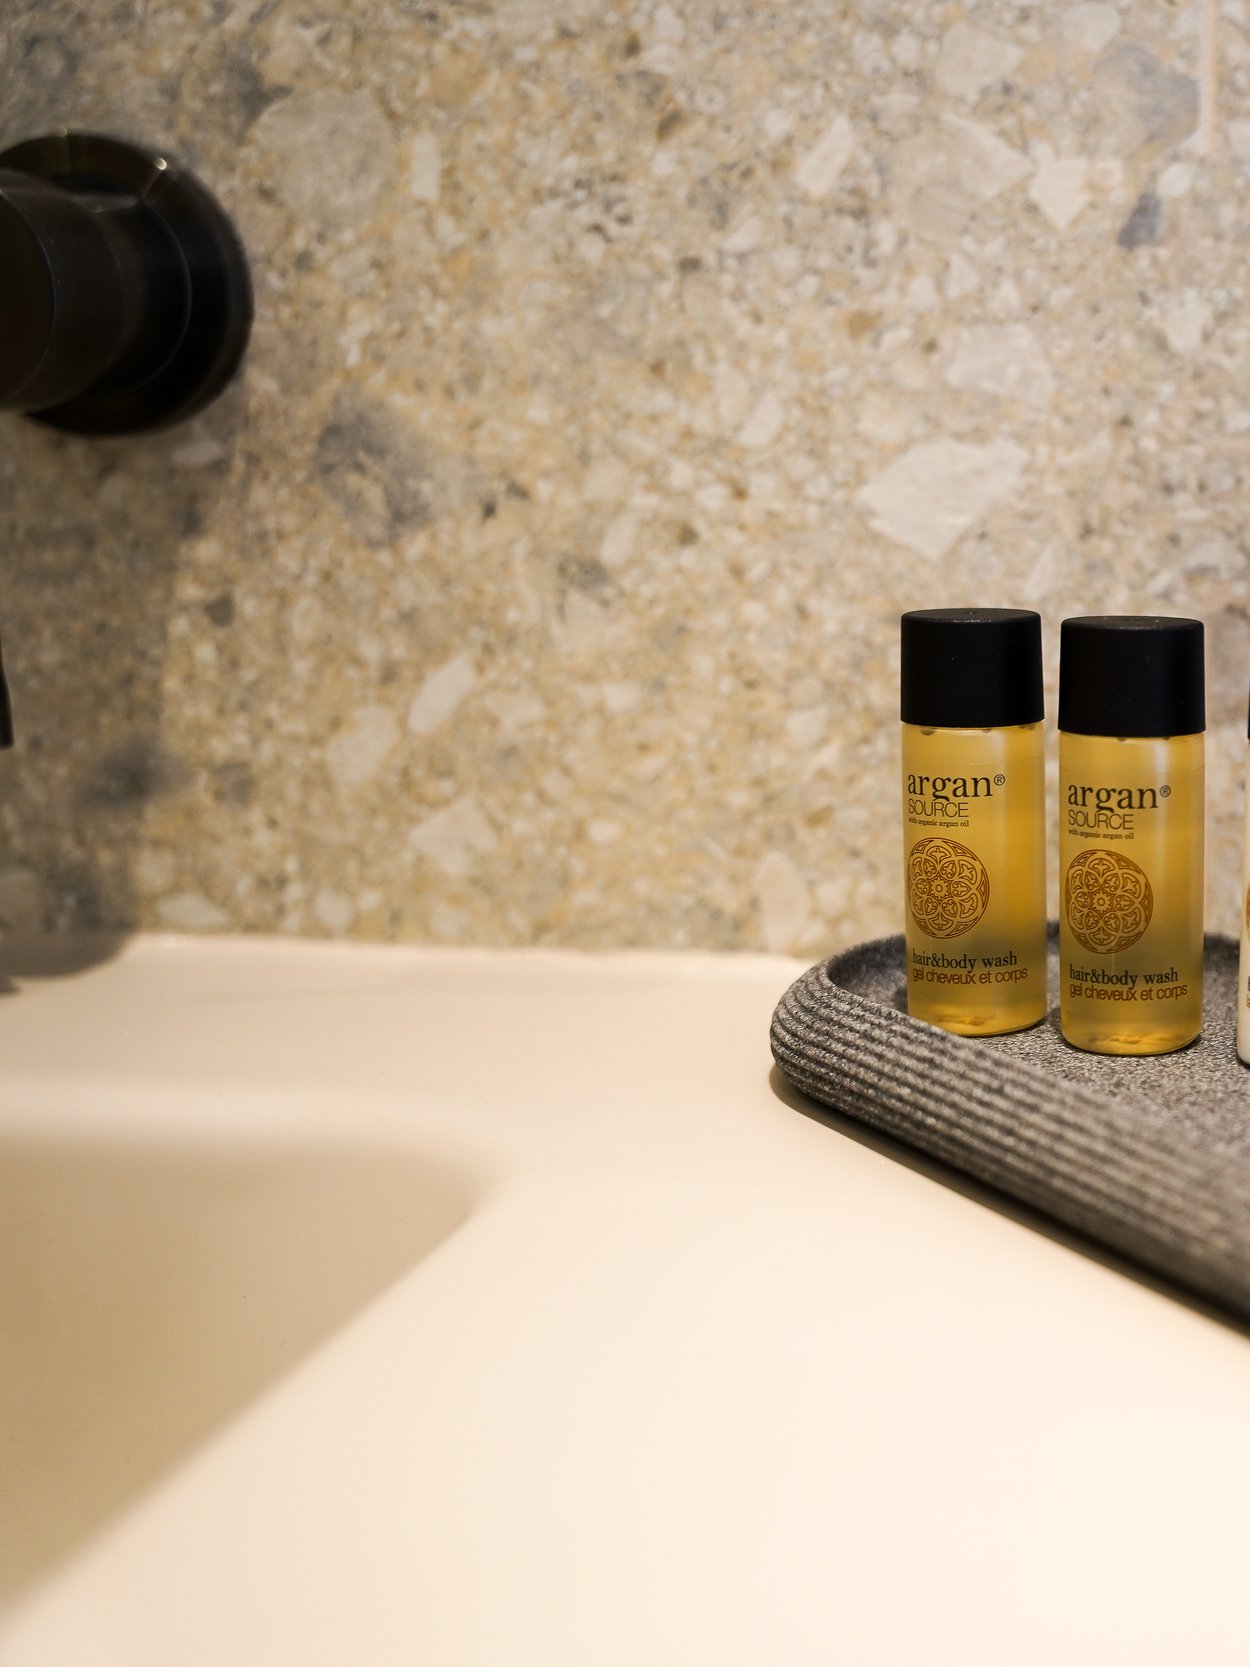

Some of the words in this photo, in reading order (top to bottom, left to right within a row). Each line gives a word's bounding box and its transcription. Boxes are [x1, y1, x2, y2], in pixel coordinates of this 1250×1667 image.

[908, 798, 969, 817] SOURCE
[918, 818, 937, 827] organic
[939, 820, 958, 828] argan
[1068, 809, 1134, 830] SOURCE
[1080, 830, 1101, 839] organic
[1125, 832, 1134, 840] oil
[912, 948, 977, 973] hair&body
[981, 951, 1018, 968] wash
[912, 967, 924, 982] gel
[926, 969, 976, 985] cheveux
[979, 971, 992, 984] et
[995, 968, 1028, 983] corps
[1069, 963, 1138, 990] hair&body
[1143, 967, 1178, 985] wash
[1069, 983, 1083, 998] gel
[1084, 985, 1138, 1001] cheveux
[1140, 987, 1153, 1001] et
[1156, 984, 1188, 1000] corps
